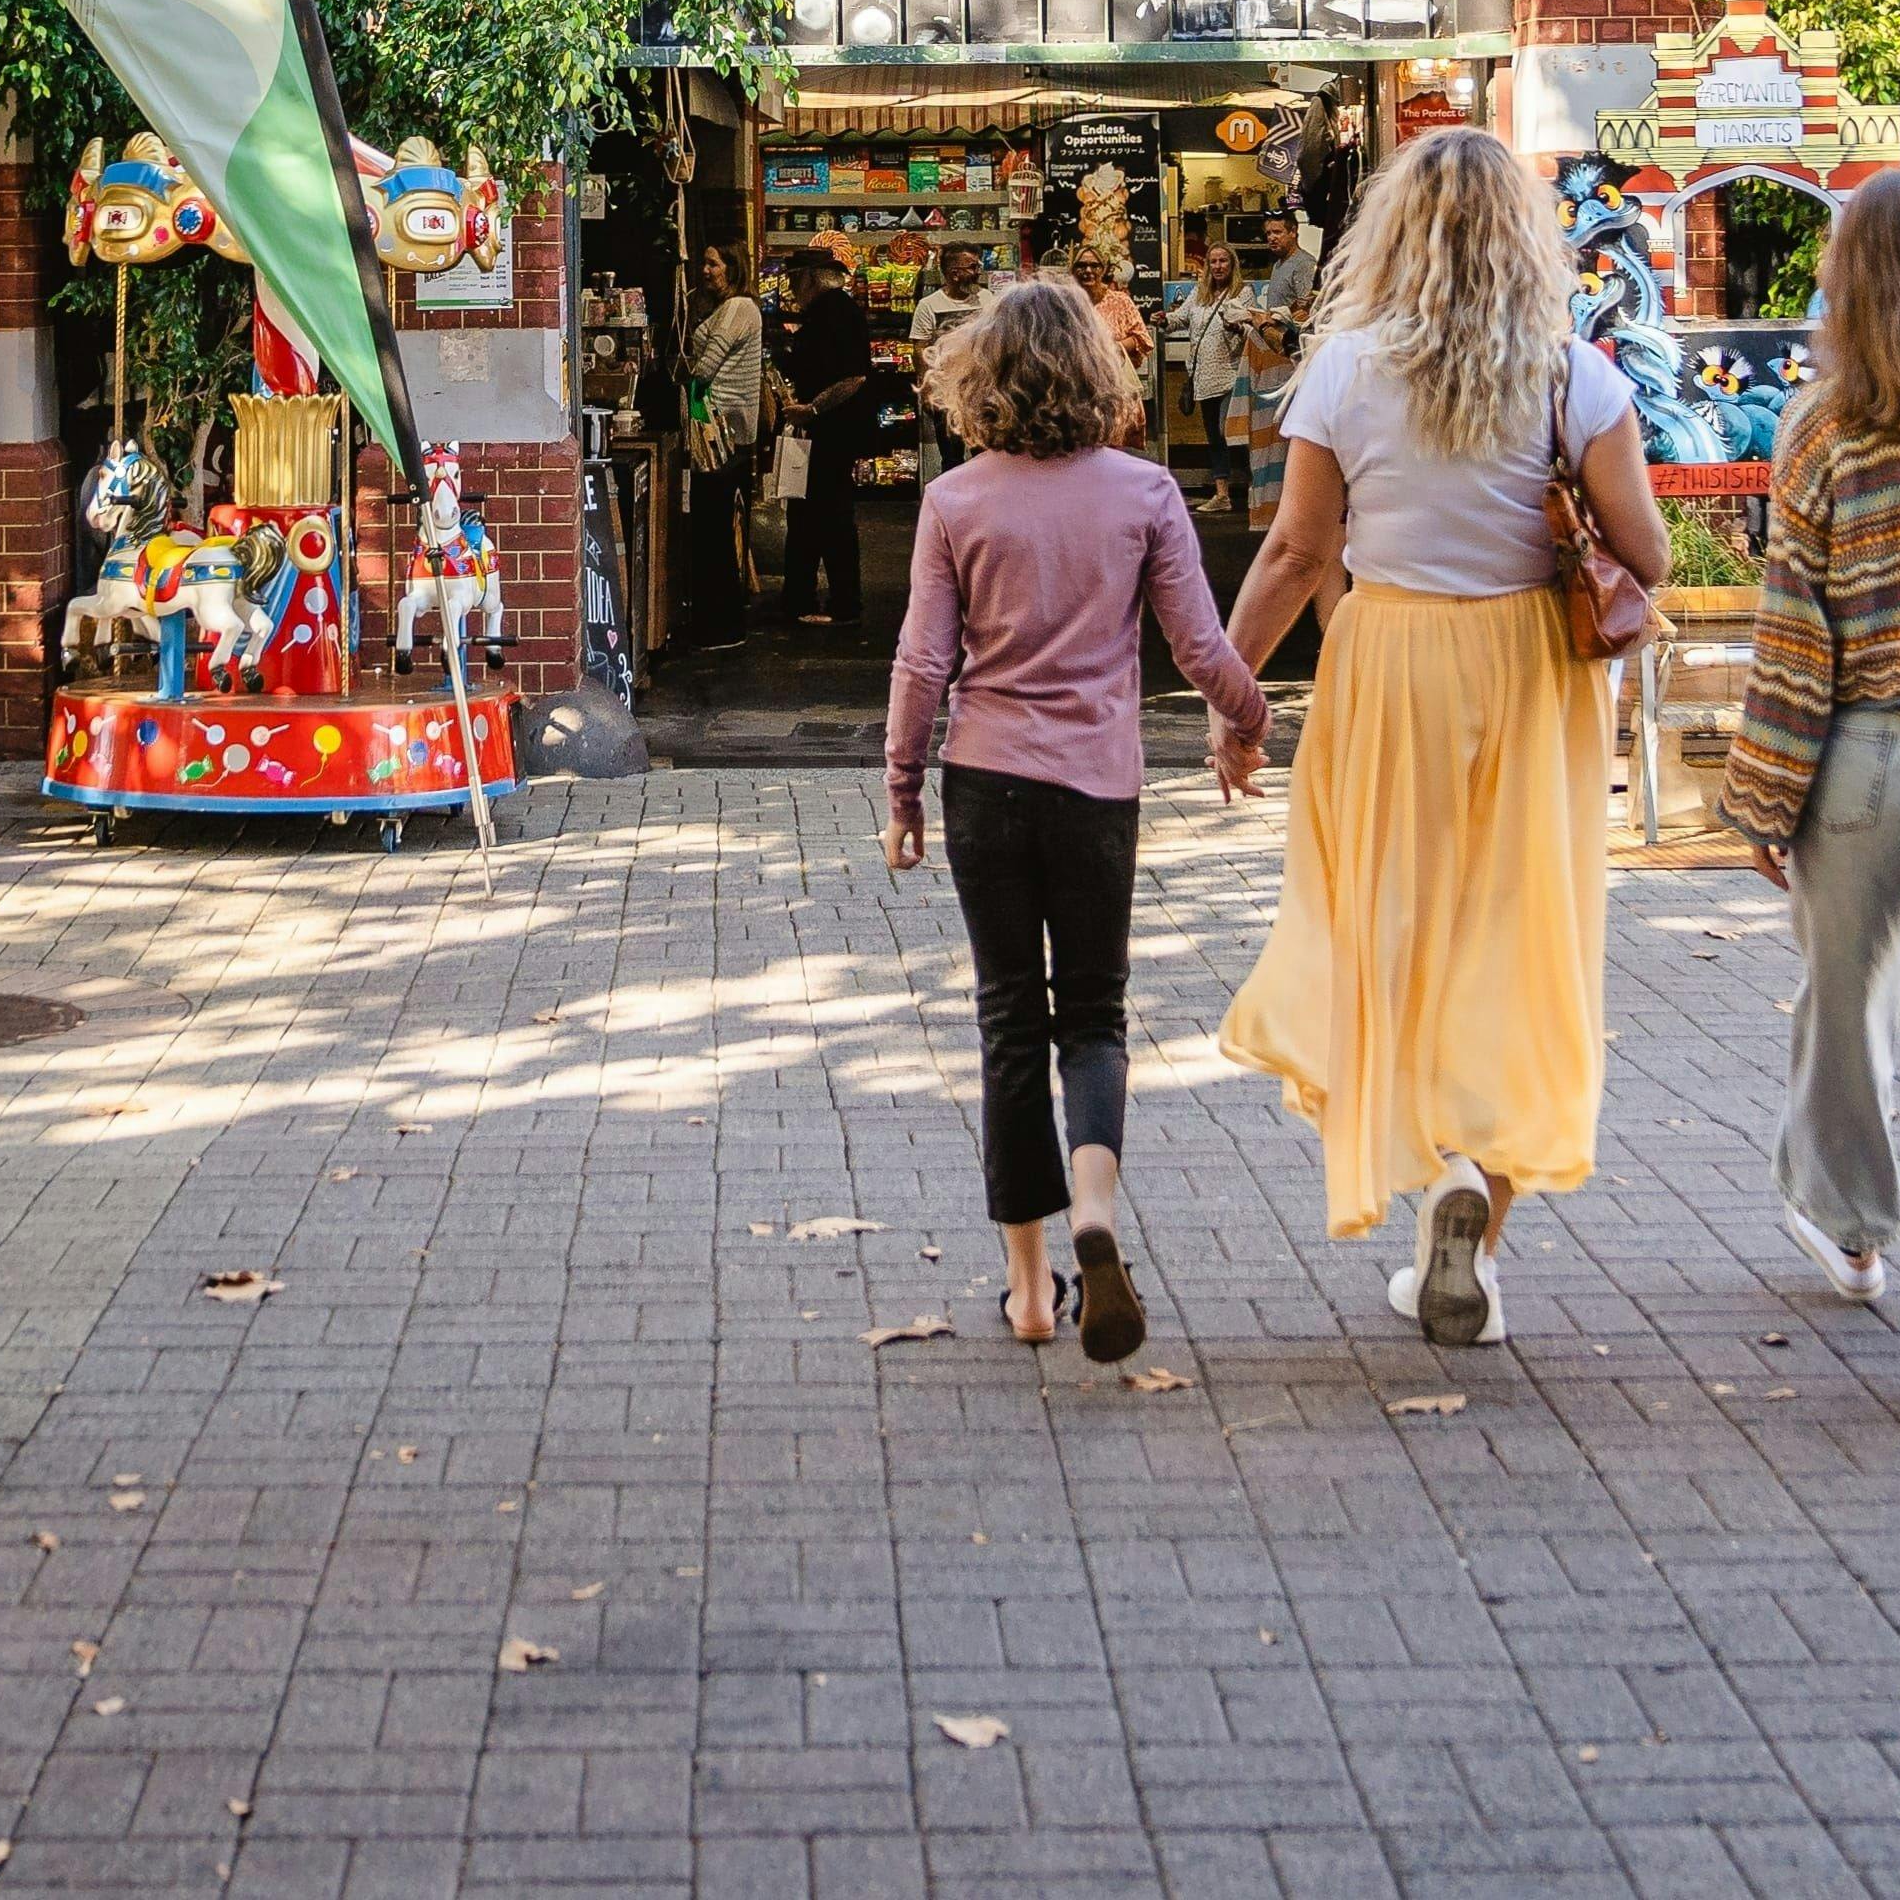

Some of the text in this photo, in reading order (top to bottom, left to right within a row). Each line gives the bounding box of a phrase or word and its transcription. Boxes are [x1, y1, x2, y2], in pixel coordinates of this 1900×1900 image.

[1697, 82, 1794, 104] #FREMANTLE
[1402, 108, 1421, 118] The
[1421, 108, 1457, 118] Perfect
[1080, 124, 1126, 135] Endless
[1713, 122, 1793, 144] MARKETS
[1064, 133, 1143, 147] Opportunities
[586, 566, 615, 626] IDEA
